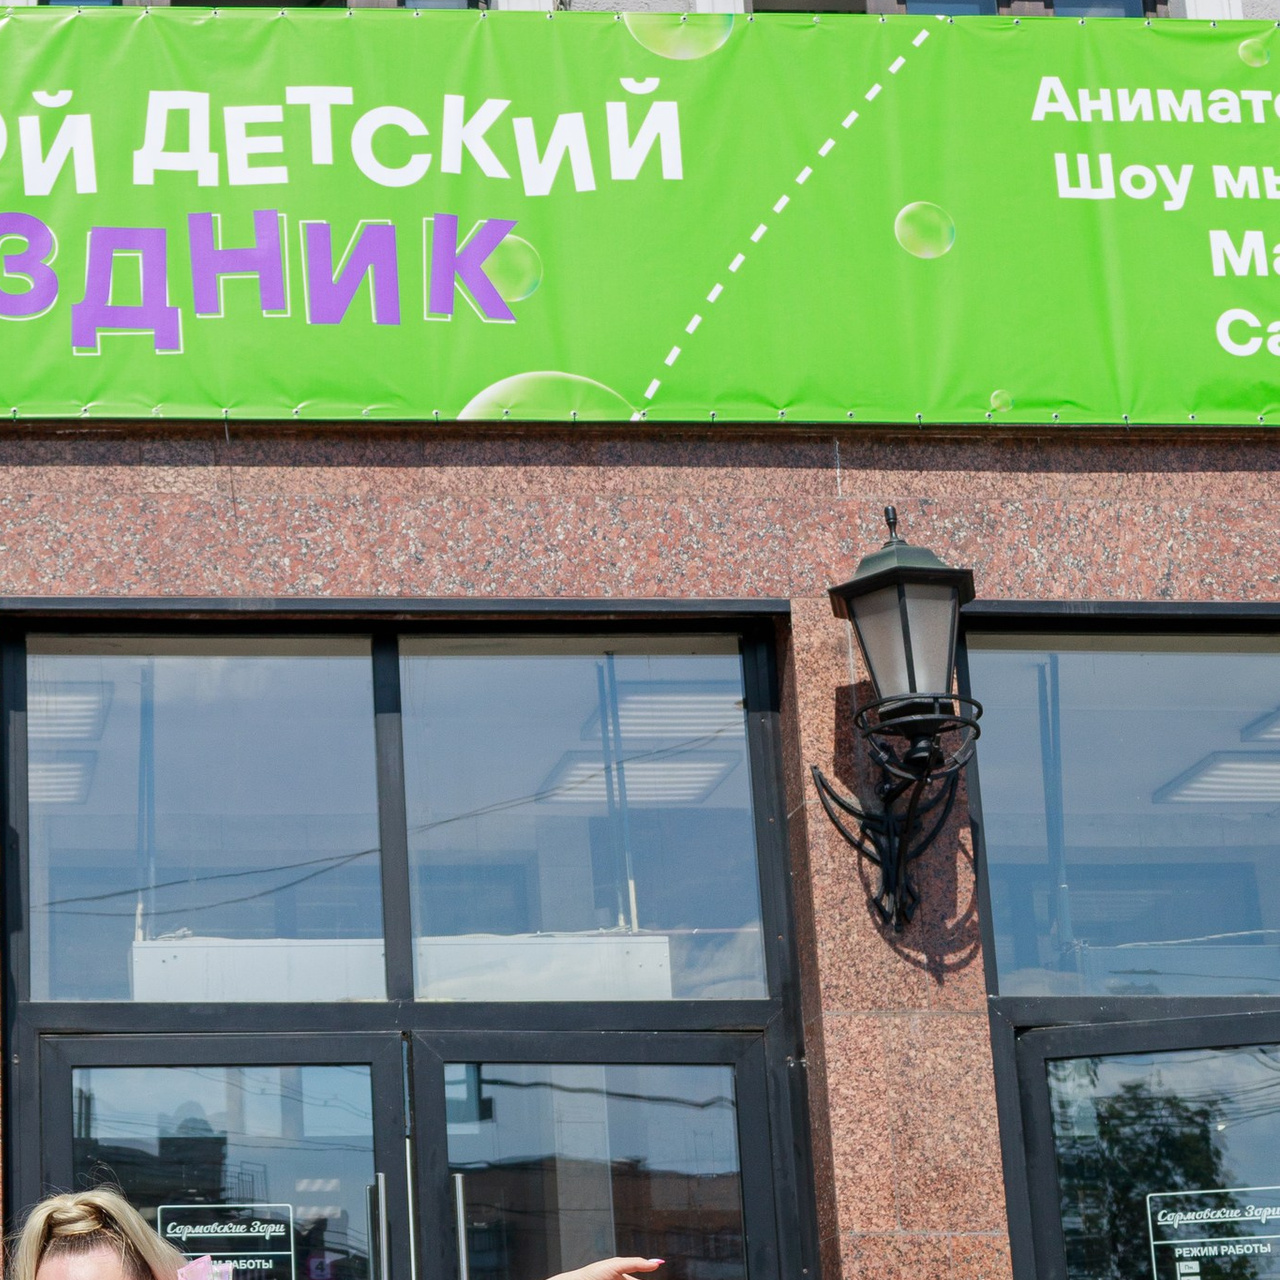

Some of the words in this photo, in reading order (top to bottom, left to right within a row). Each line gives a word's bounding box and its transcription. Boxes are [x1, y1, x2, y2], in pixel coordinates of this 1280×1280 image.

[1031, 76, 1280, 124] Анимат
[133, 77, 683, 197] ДЕТСКИЙ
[1054, 152, 1194, 211] Шоу
[1209, 230, 1280, 277] М
[166, 1222, 247, 1241] Сормовские
[250, 1221, 285, 1240] Зори
[1158, 1208, 1241, 1229] Сормовские
[1175, 1246, 1218, 1257] РЕЖИМ
[1221, 1243, 1271, 1255] РАБОТЫ
